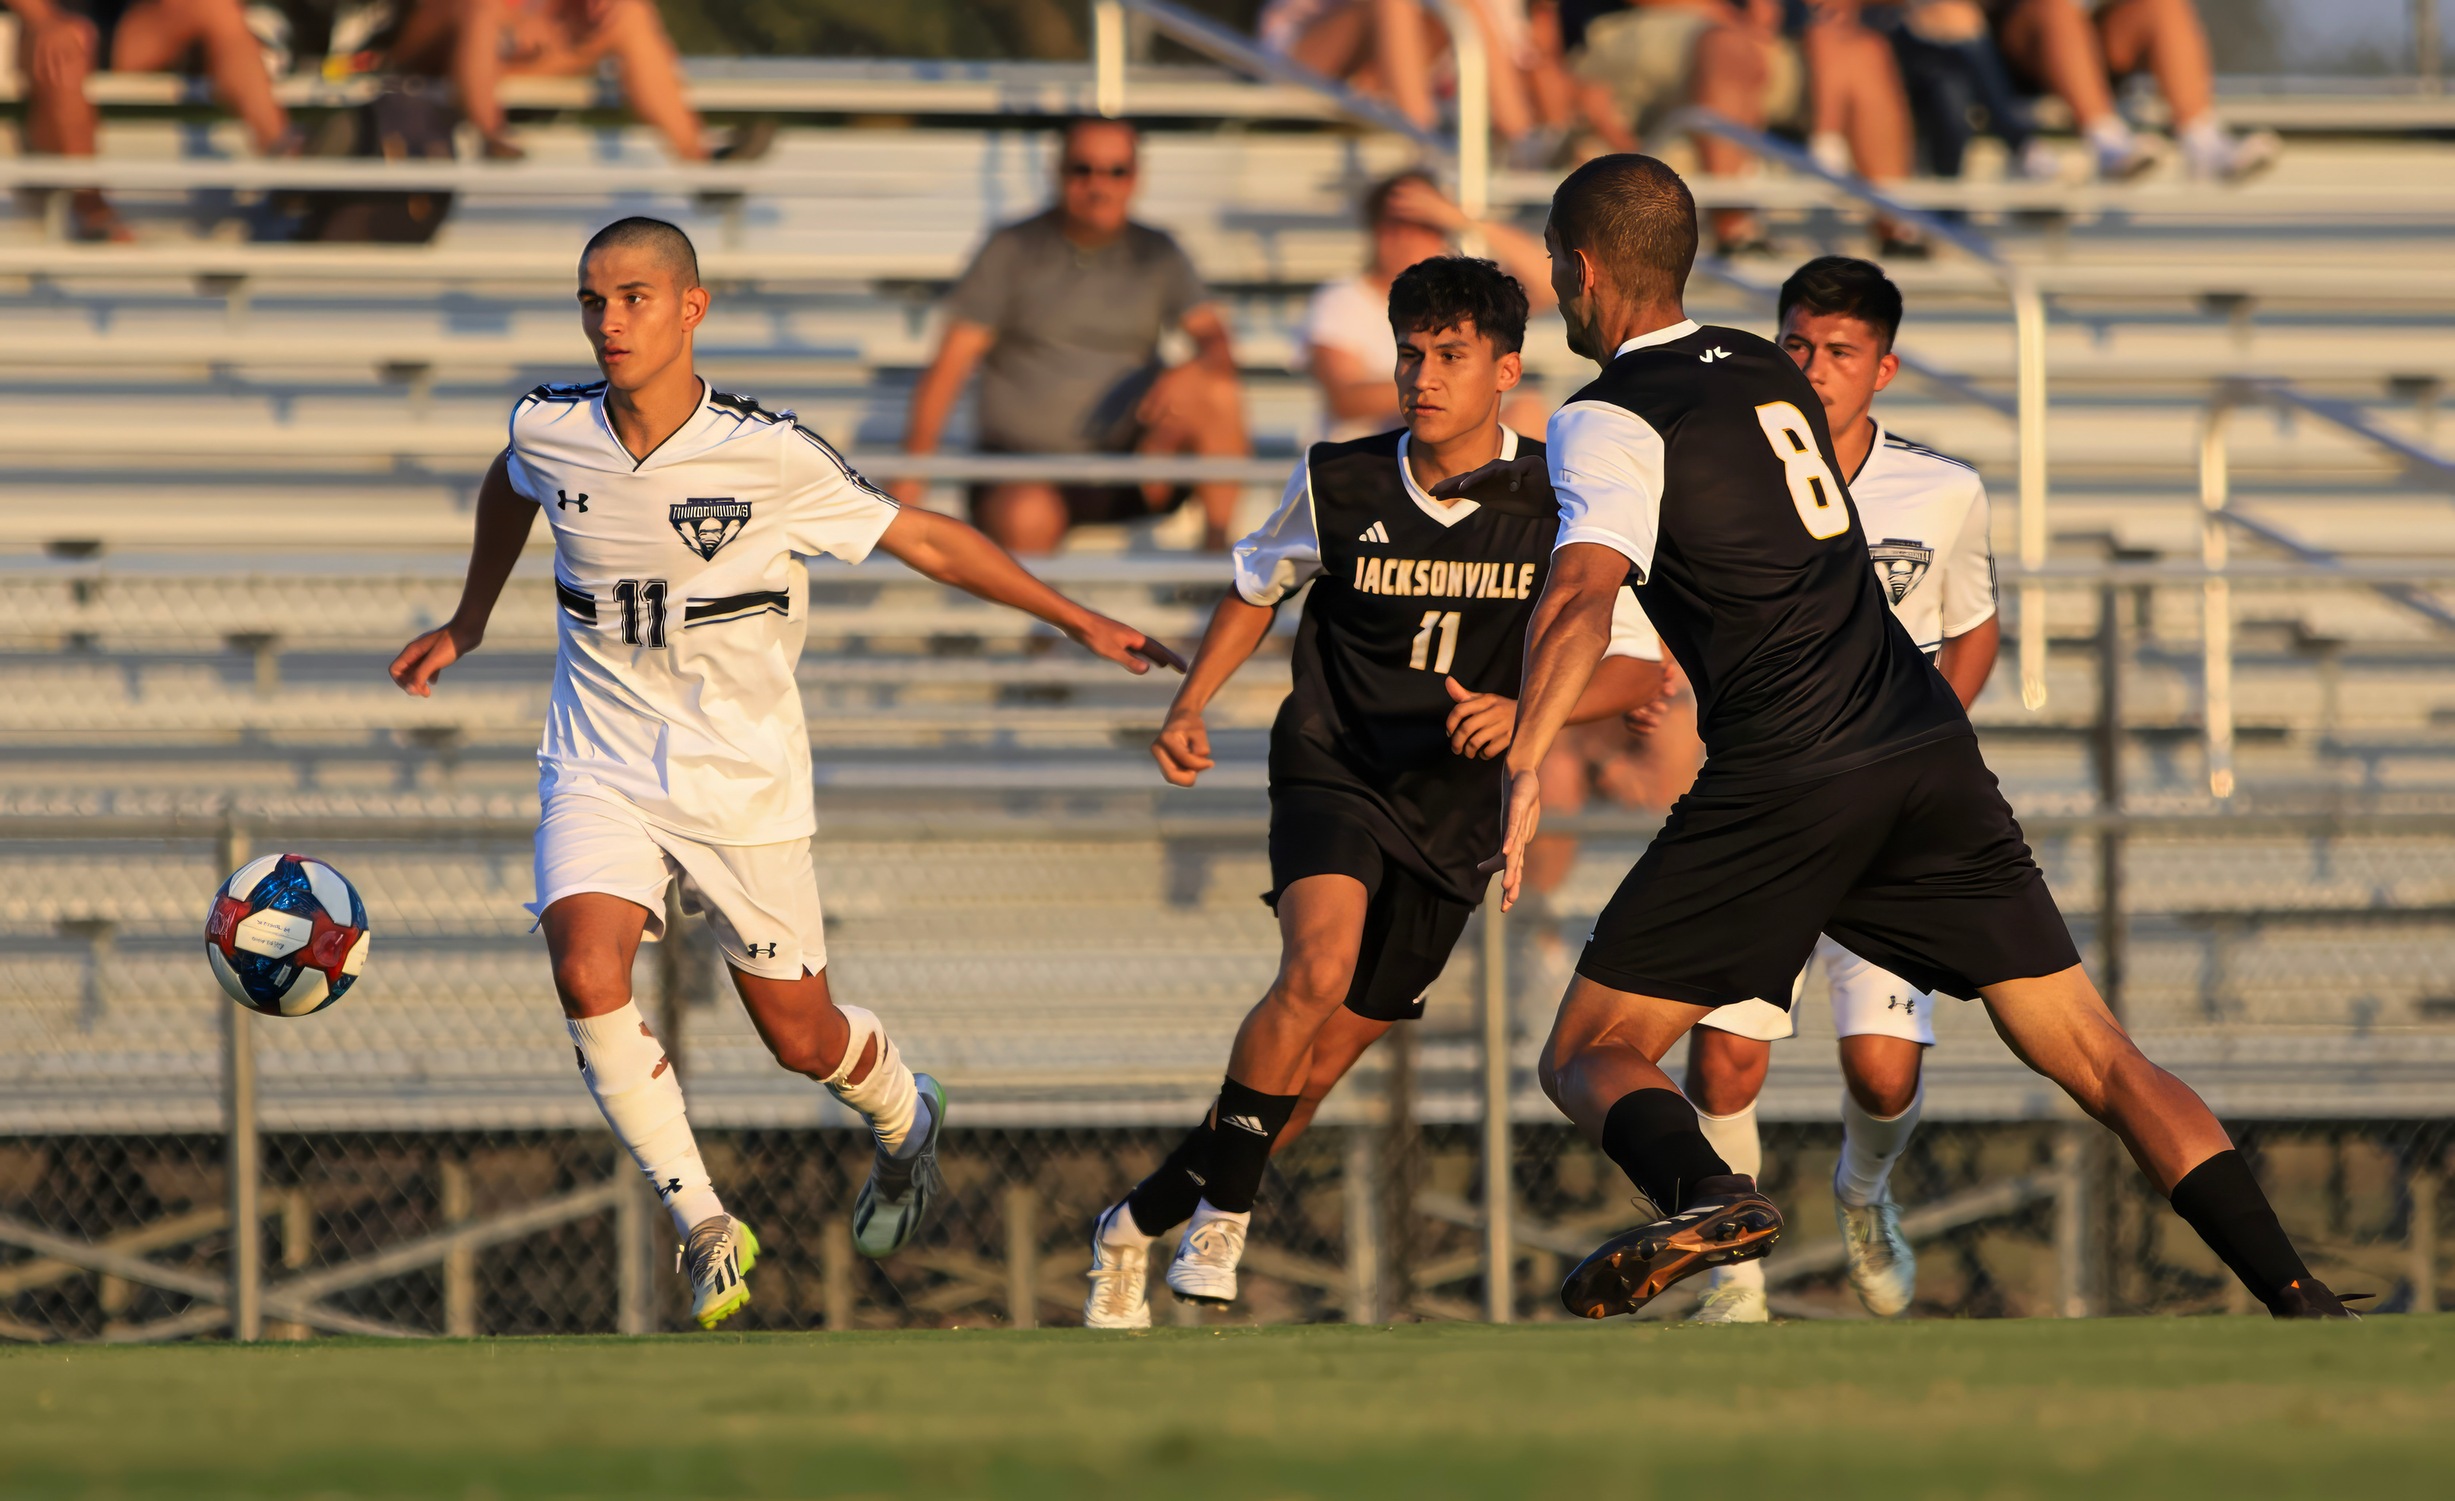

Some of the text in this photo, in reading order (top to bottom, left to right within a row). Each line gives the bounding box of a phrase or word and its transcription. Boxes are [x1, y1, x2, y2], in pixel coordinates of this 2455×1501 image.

[1754, 400, 1850, 540] 8
[1353, 556, 1535, 600] JACKSONVILLE
[613, 579, 667, 648] 11
[1409, 610, 1461, 675] 11
